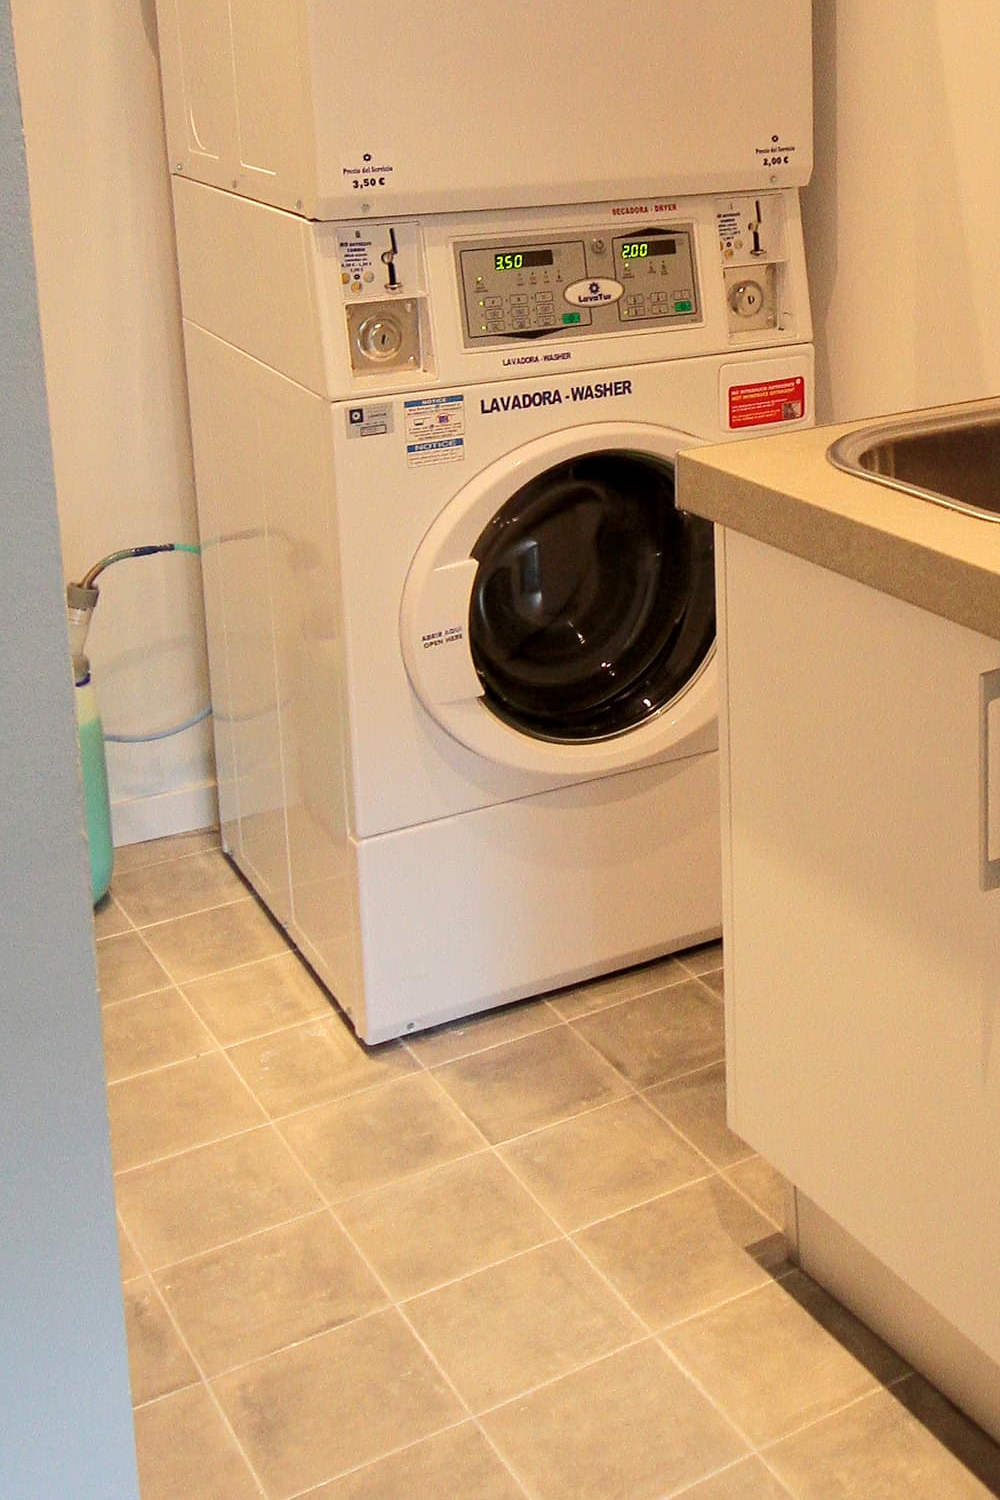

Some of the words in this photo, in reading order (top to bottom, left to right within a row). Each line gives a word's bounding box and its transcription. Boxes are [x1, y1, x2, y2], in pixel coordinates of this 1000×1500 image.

[352, 178, 377, 189] 3,50
[612, 205, 649, 216] SECADORA
[502, 355, 539, 366] LAVADORA
[480, 389, 562, 414] LAVADORA
[571, 380, 632, 401] WASHER
[415, 440, 457, 451] NOTICE
